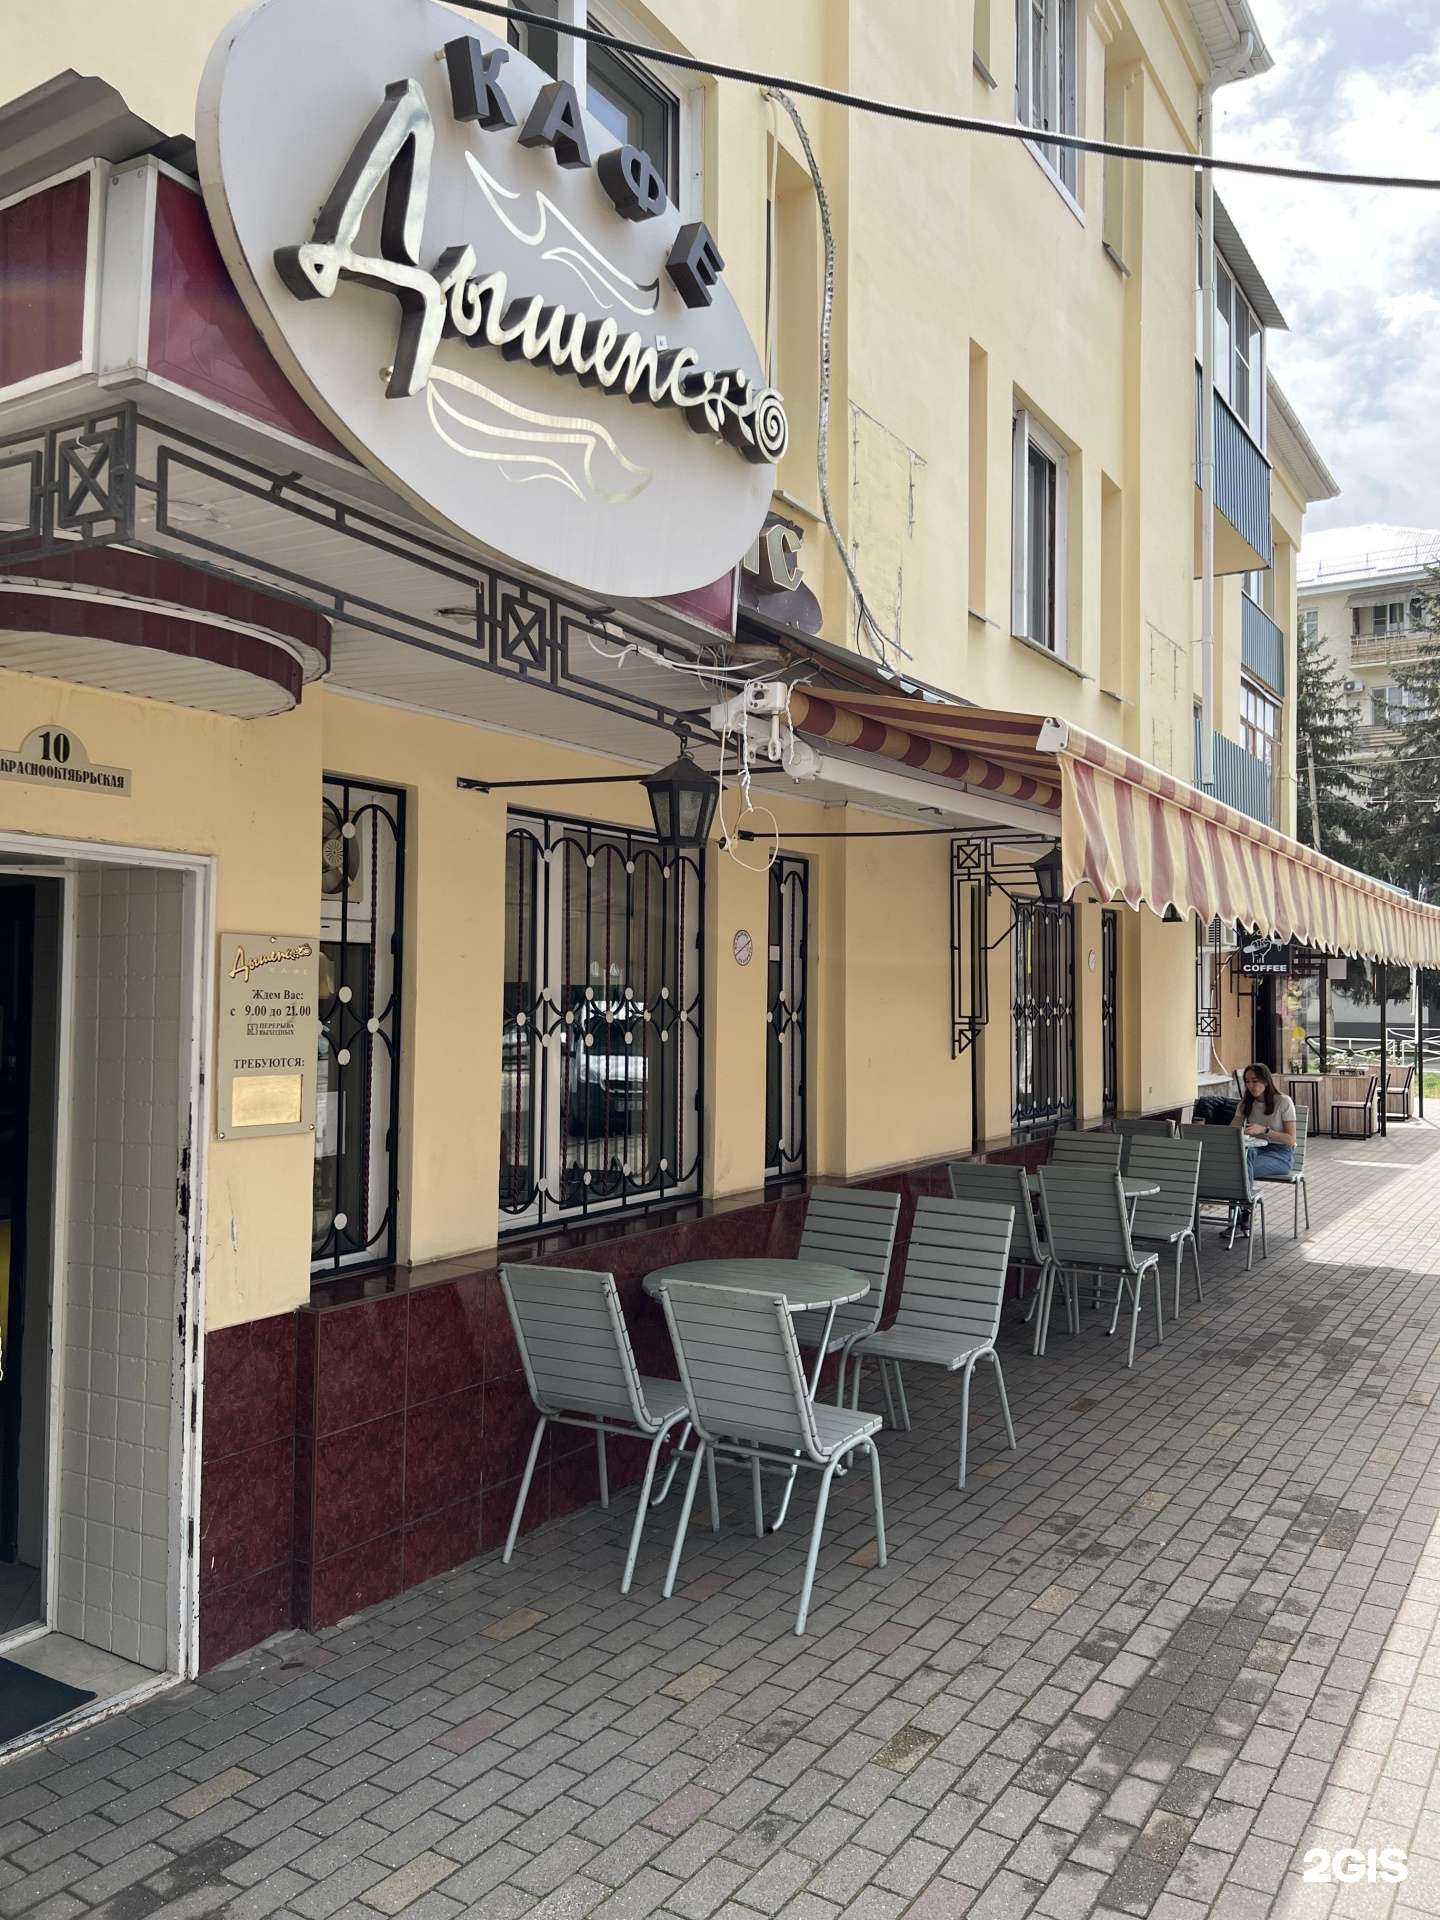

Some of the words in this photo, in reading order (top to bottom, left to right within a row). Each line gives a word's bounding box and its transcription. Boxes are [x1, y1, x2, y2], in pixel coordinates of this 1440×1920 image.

[443, 35, 727, 309] КАФЕ
[39, 731, 70, 764] 10
[0, 758, 125, 788] КРАСНООКТЯБРЬСКАЯ
[1243, 964, 1287, 972] COFFEE
[251, 989, 281, 1000] Ждем
[283, 989, 305, 1000] Вас:
[230, 1008, 236, 1016] с
[244, 1004, 267, 1016] 9.00
[269, 1008, 282, 1017] до
[285, 1005, 311, 1017] 21.00
[233, 1057, 305, 1069] ТРЕБУЮТСЯ:
